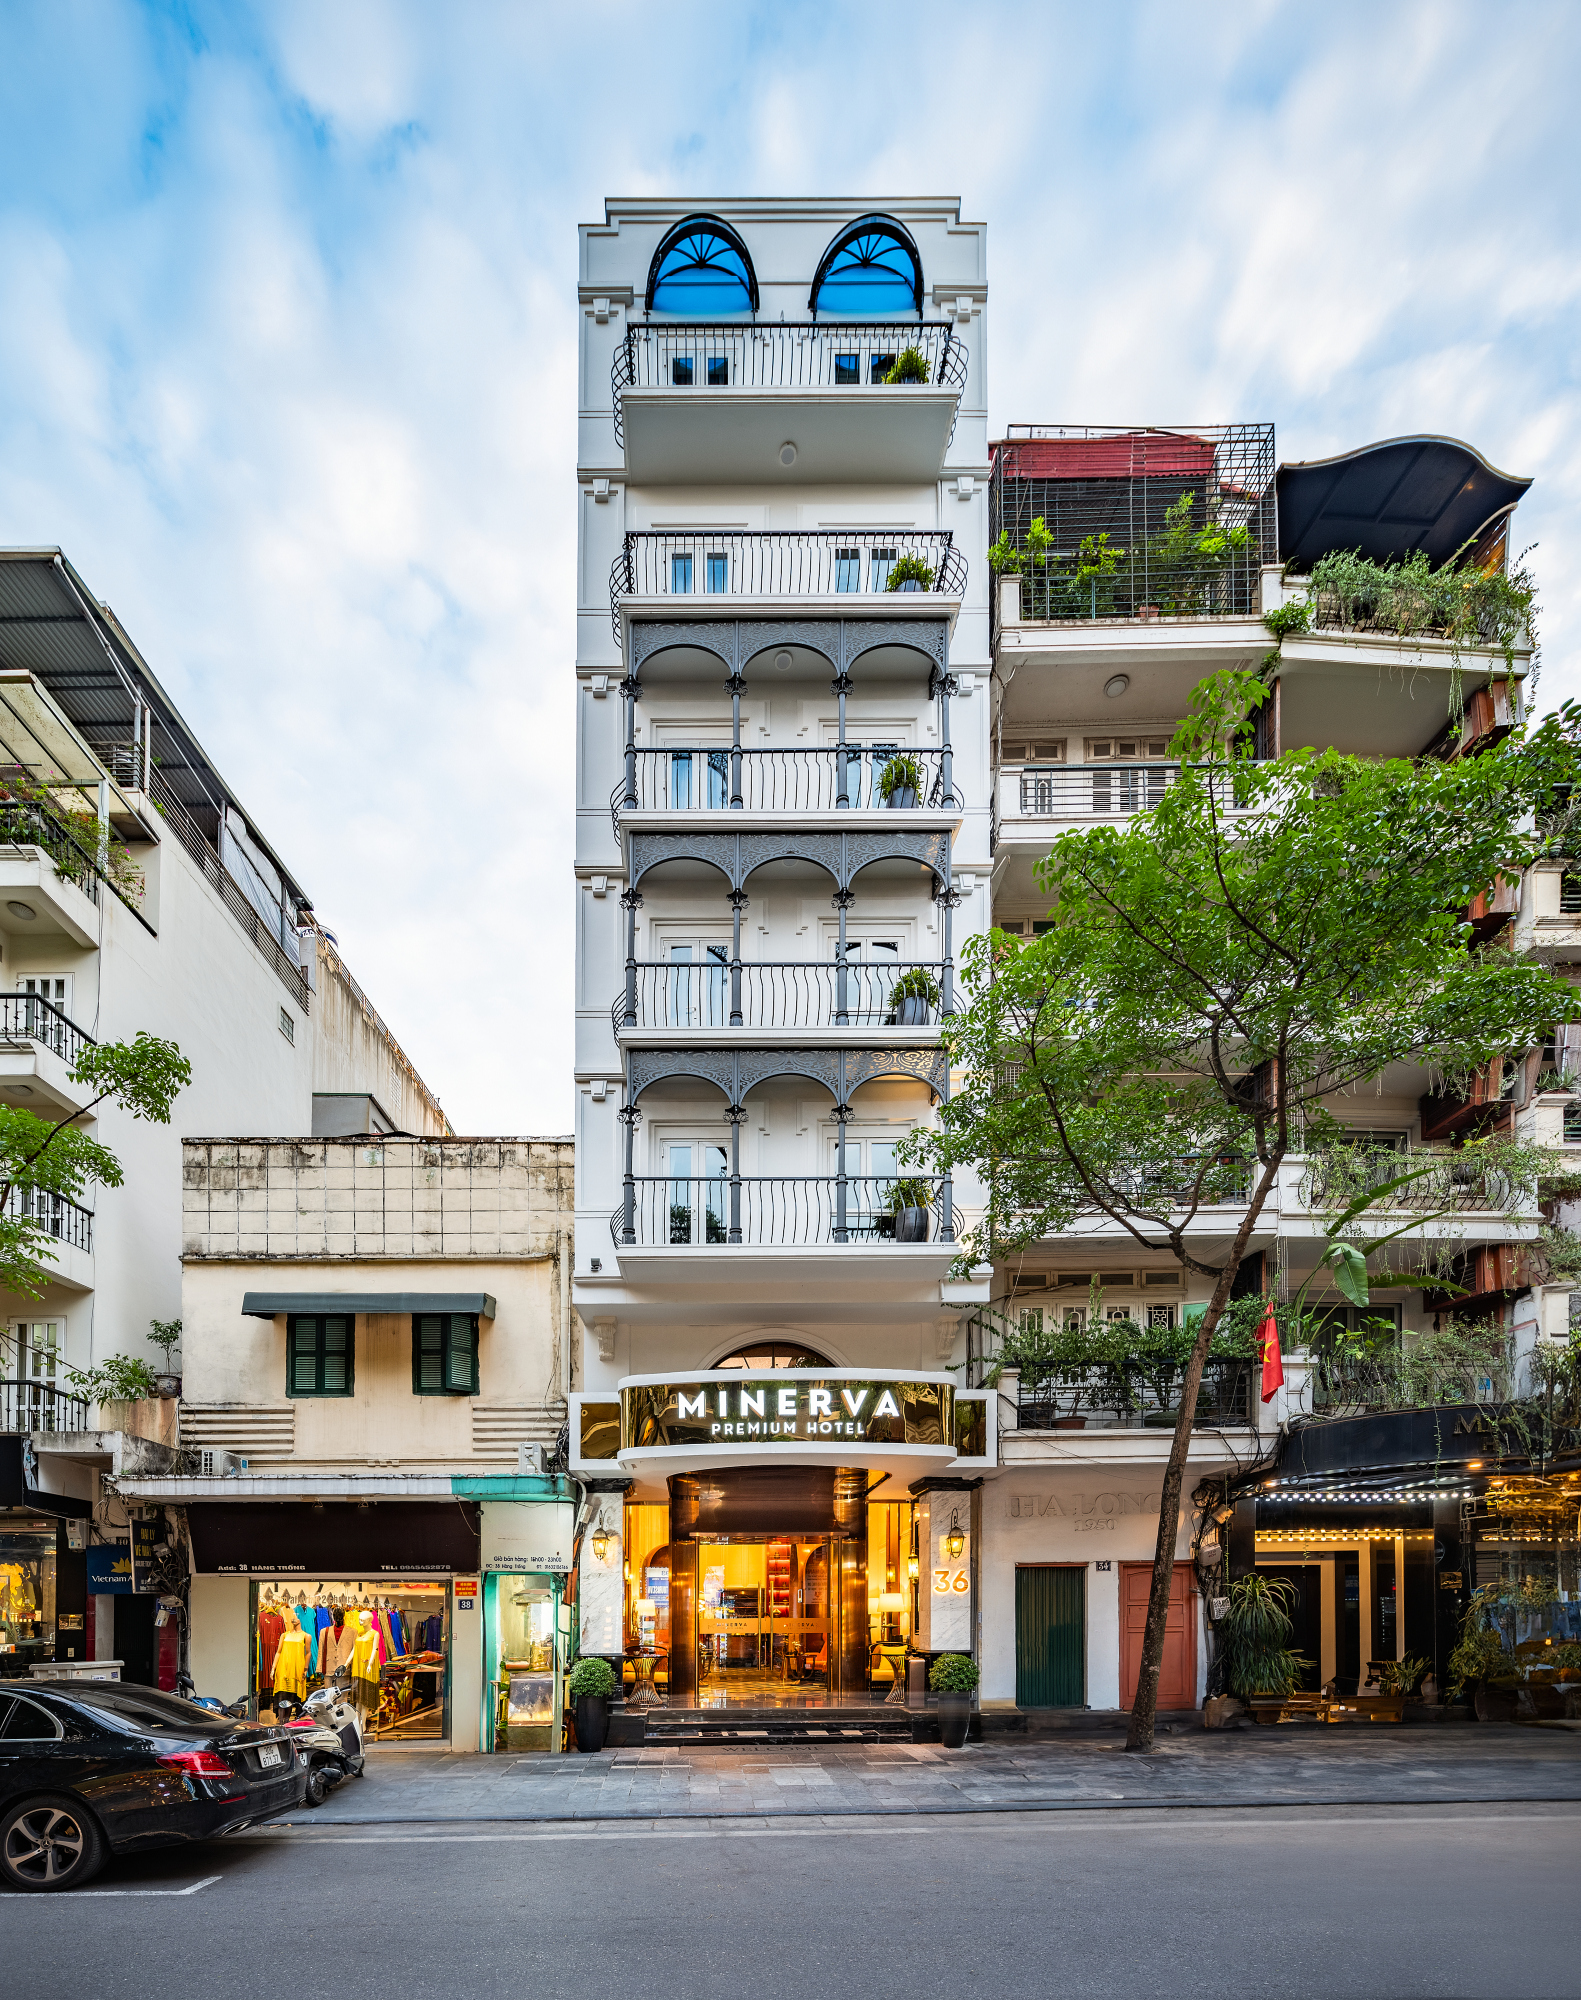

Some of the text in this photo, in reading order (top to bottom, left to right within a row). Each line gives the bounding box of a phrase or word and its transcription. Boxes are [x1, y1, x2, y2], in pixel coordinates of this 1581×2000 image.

[678, 1389, 900, 1419] MINERVA
[711, 1421, 865, 1435] PREMIUM HOTEL
[1074, 1518, 1117, 1531] 1950
[1098, 1562, 1109, 1571] 34
[934, 1570, 968, 1592] 36
